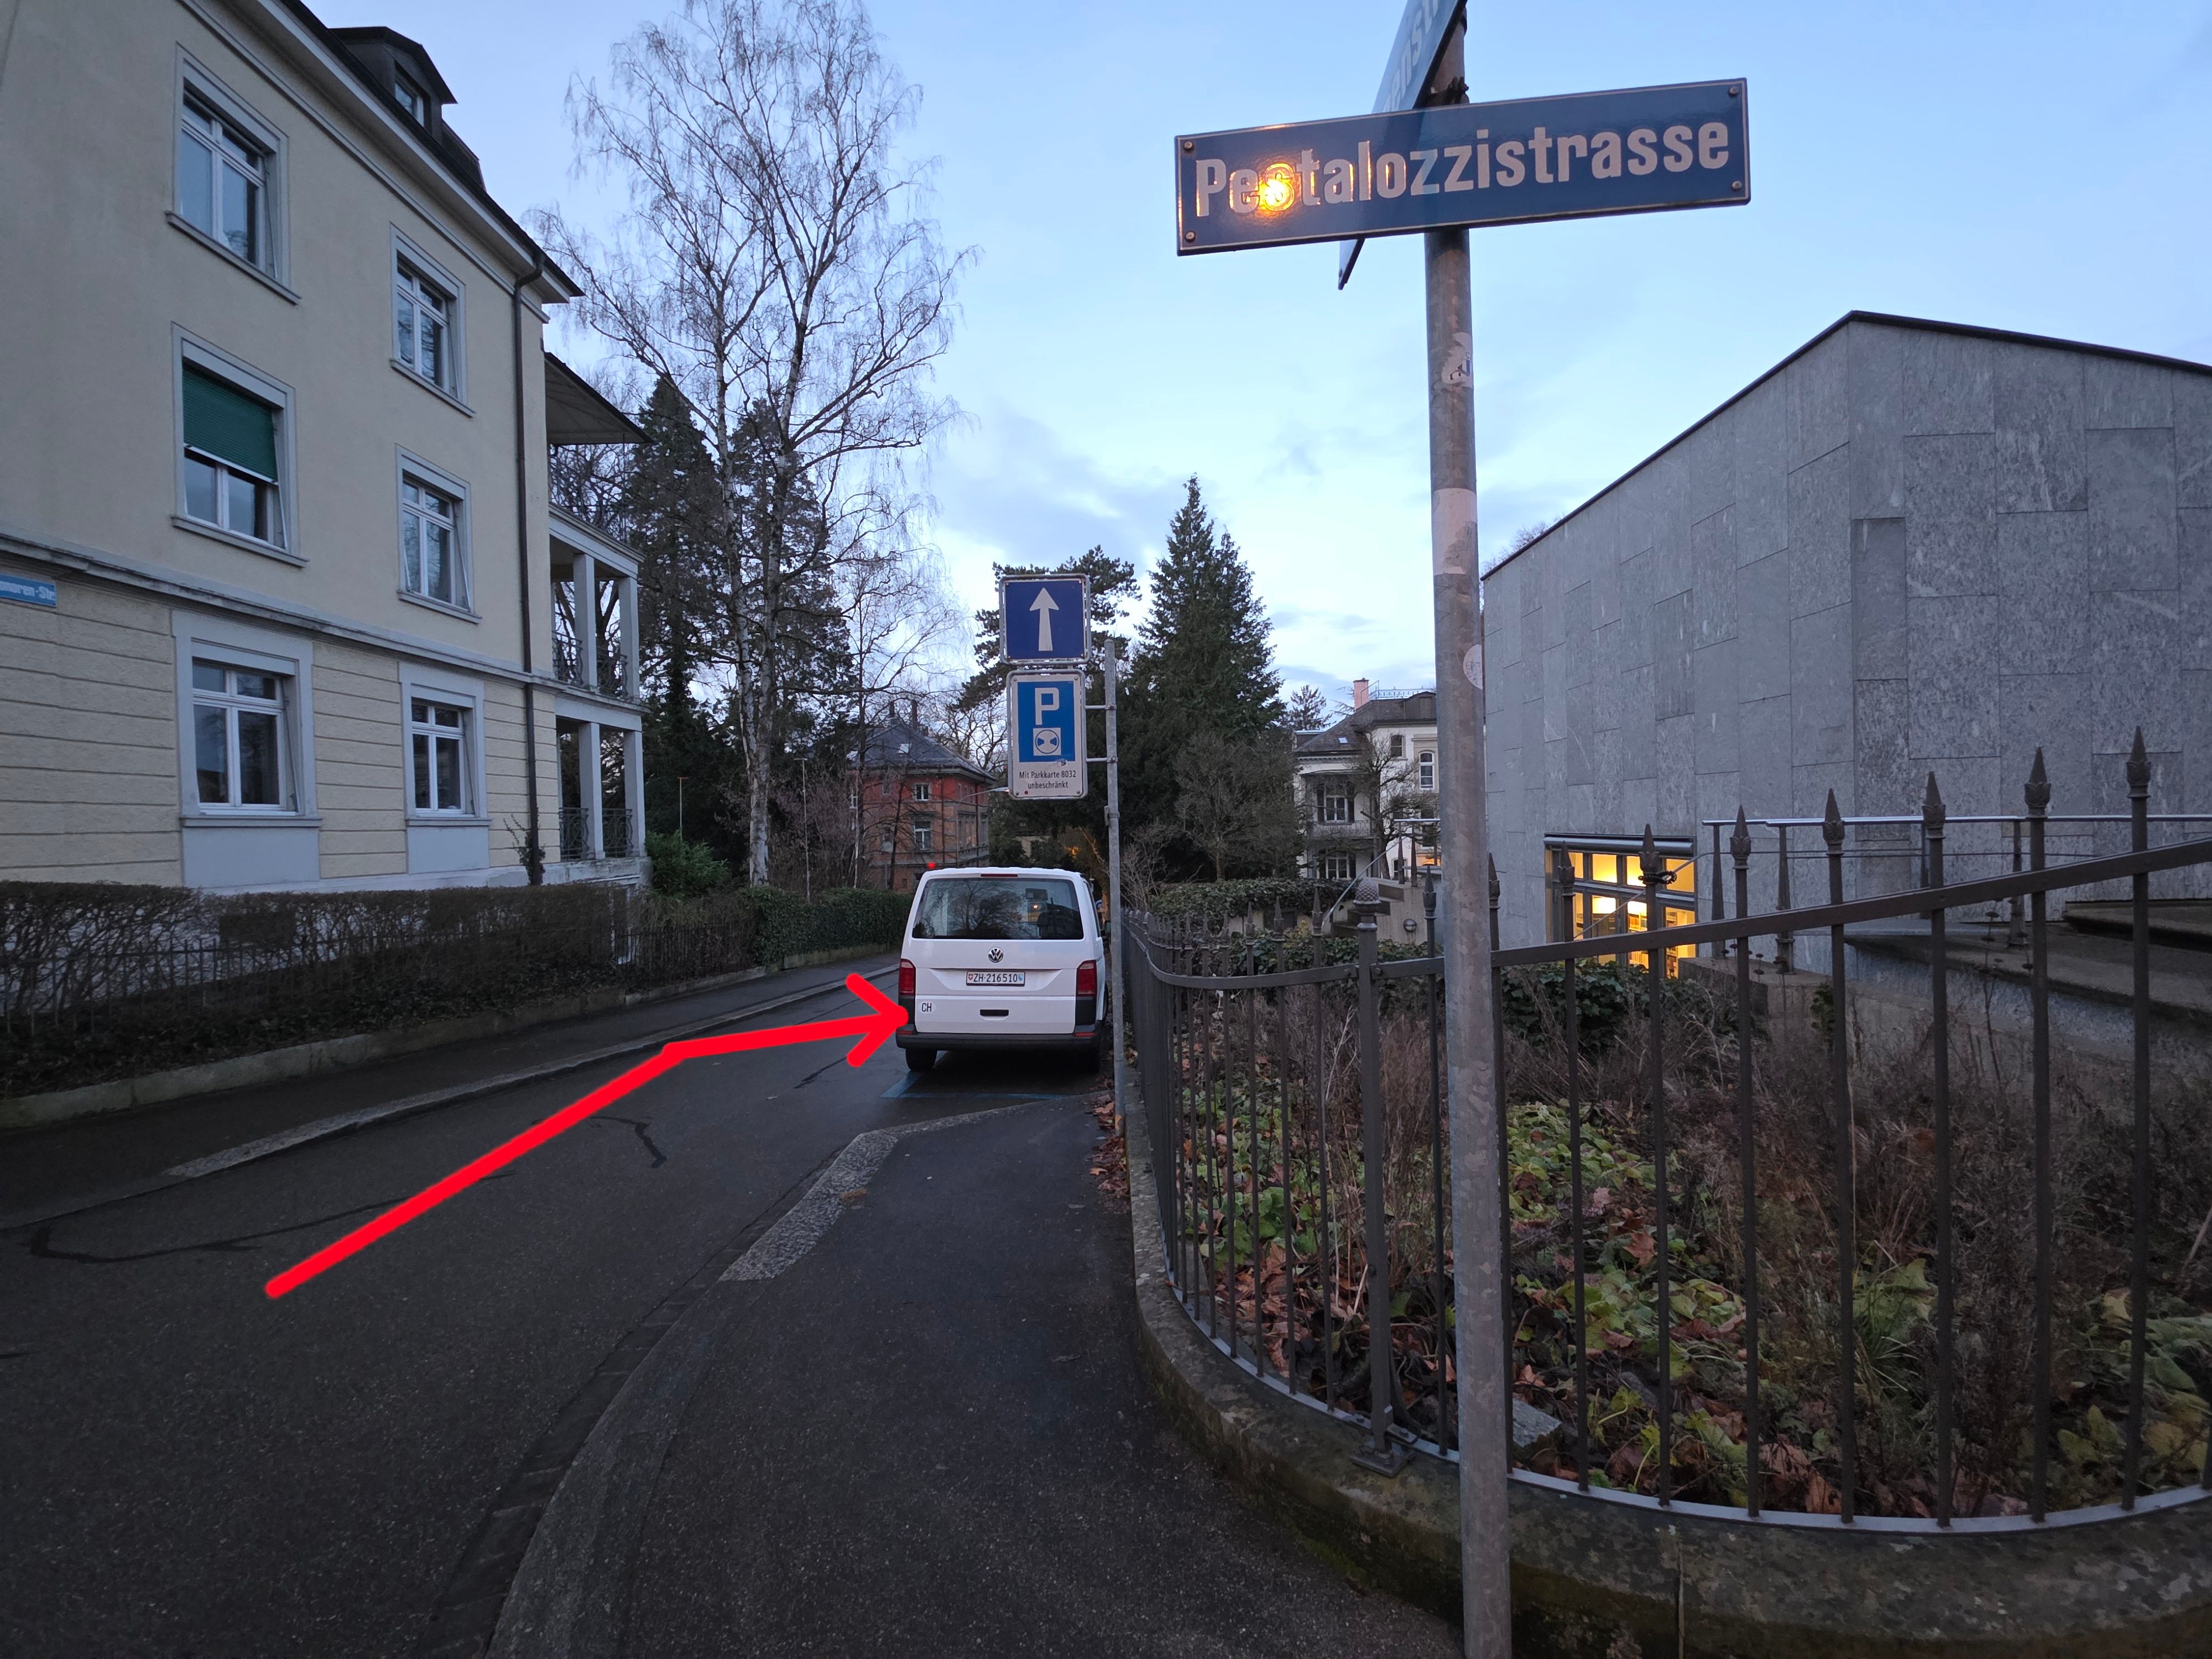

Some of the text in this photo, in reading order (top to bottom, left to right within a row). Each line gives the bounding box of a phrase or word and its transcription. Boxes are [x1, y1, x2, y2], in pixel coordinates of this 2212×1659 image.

[1196, 122, 1729, 217] Pestalozzistrasse
[1035, 687, 1060, 726] P
[1027, 780, 1068, 789] unbeschränkt
[921, 1003, 932, 1013] CH
